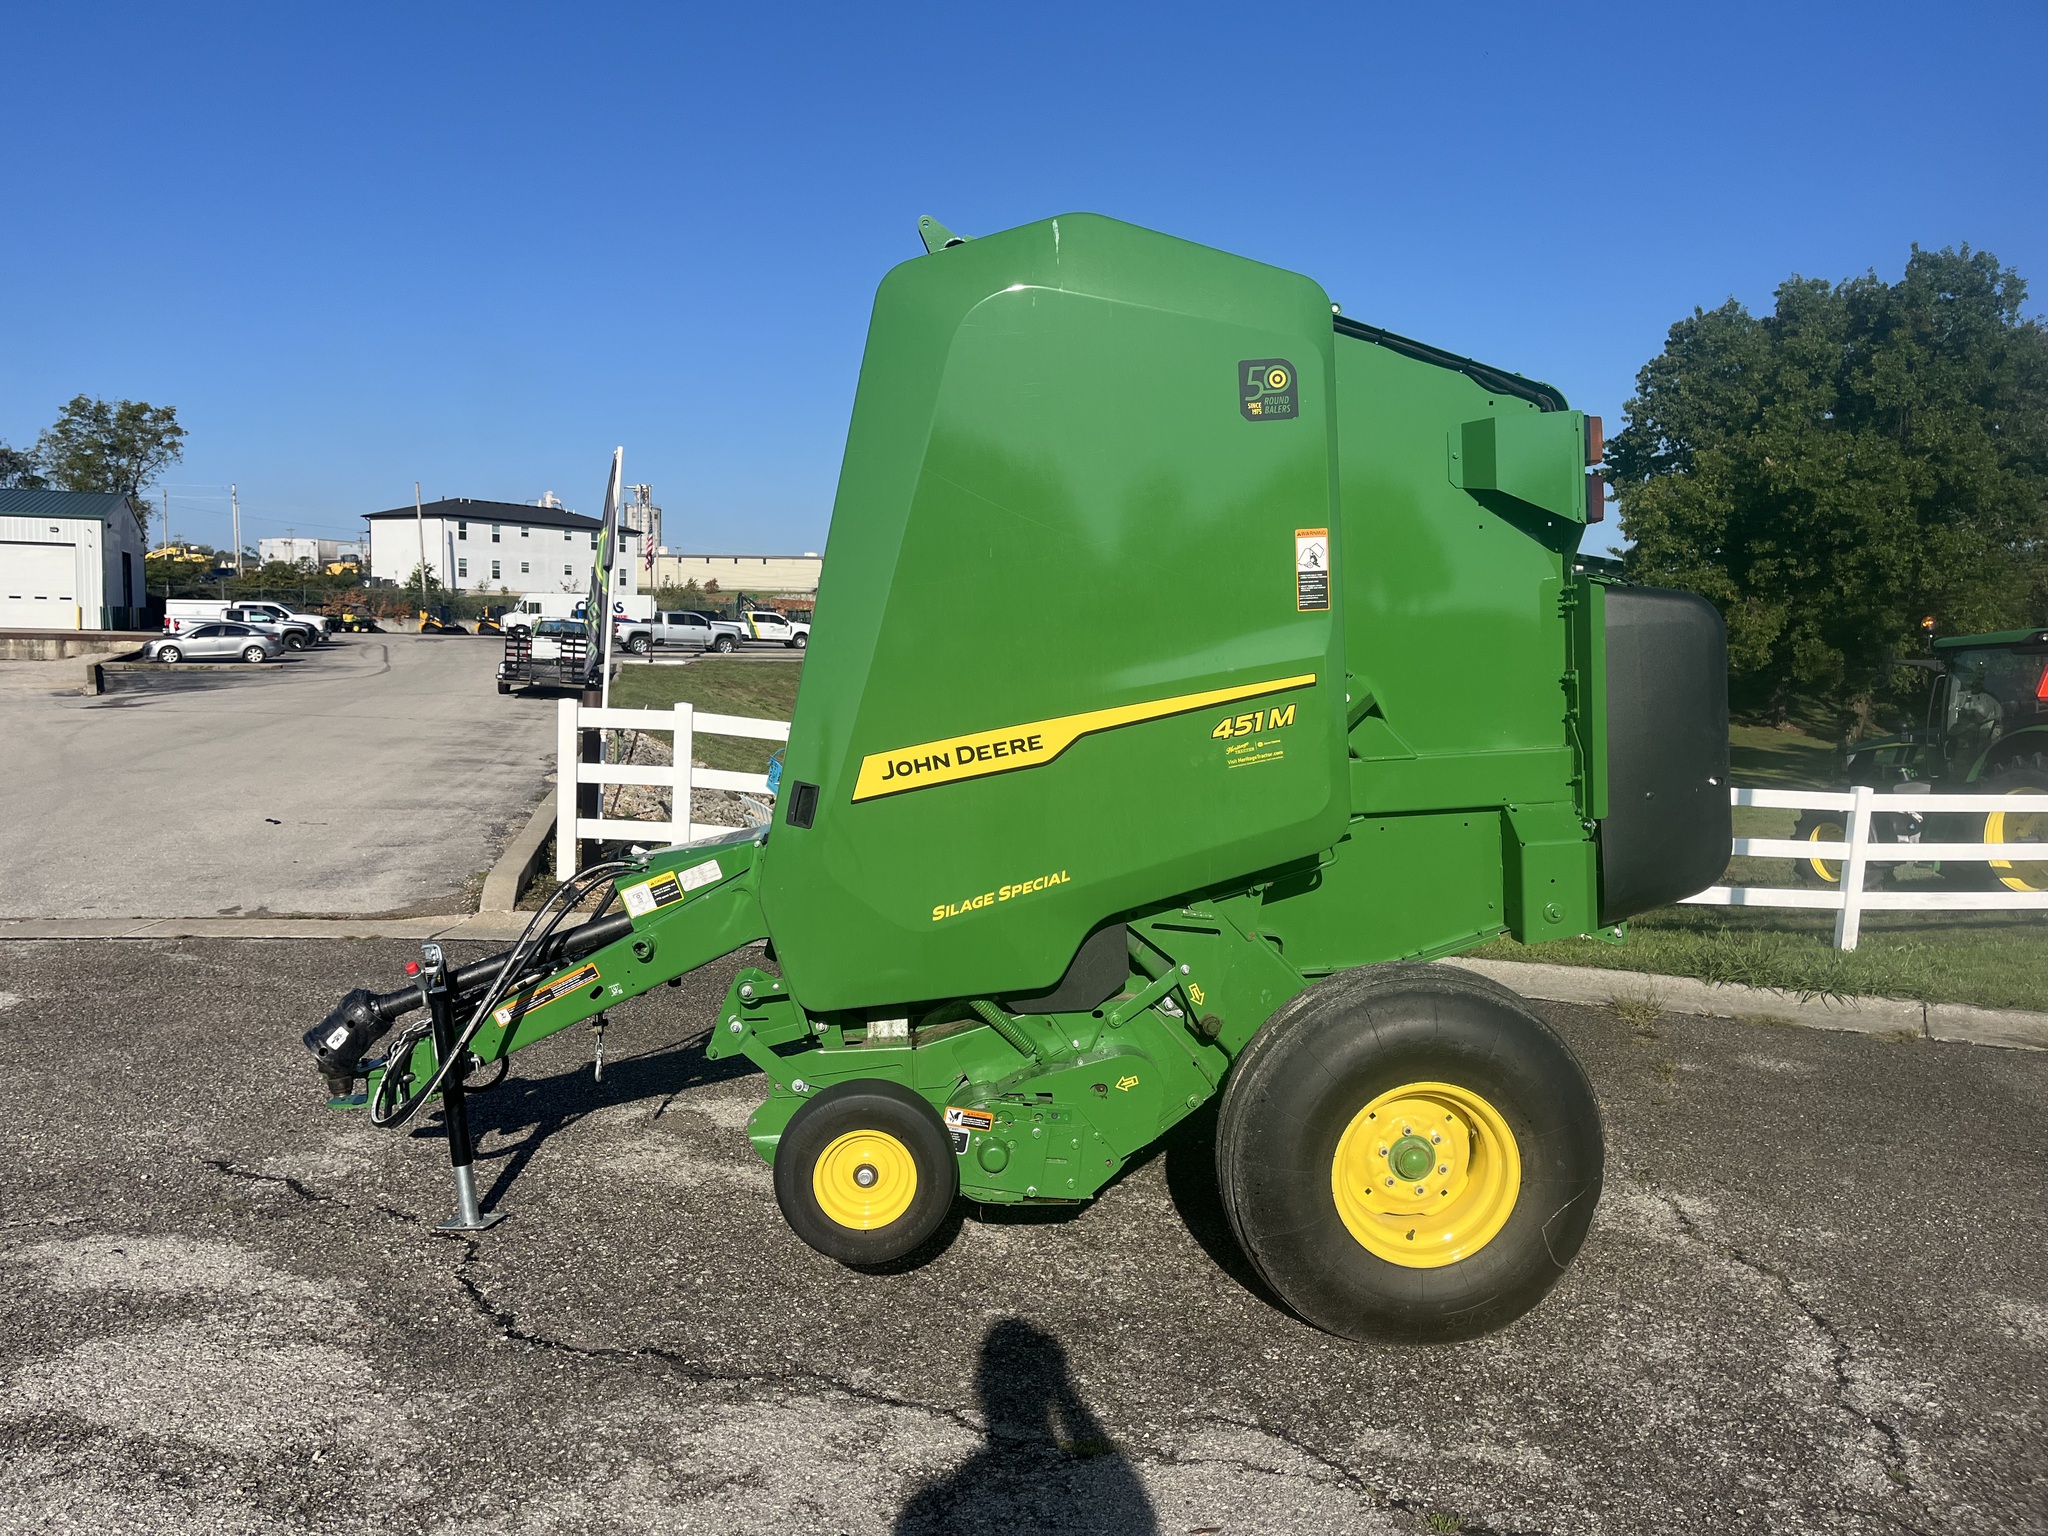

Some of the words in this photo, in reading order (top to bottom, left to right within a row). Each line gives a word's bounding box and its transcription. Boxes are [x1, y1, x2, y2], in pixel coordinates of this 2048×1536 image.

[1245, 364, 1292, 401] 50
[1264, 396, 1290, 406] ROUND
[1264, 404, 1291, 414] BALERS
[882, 753, 951, 781] JOHN
[955, 734, 1044, 765] DEERE
[932, 892, 995, 921] SILAGE
[998, 870, 1071, 902] SPECIAL
